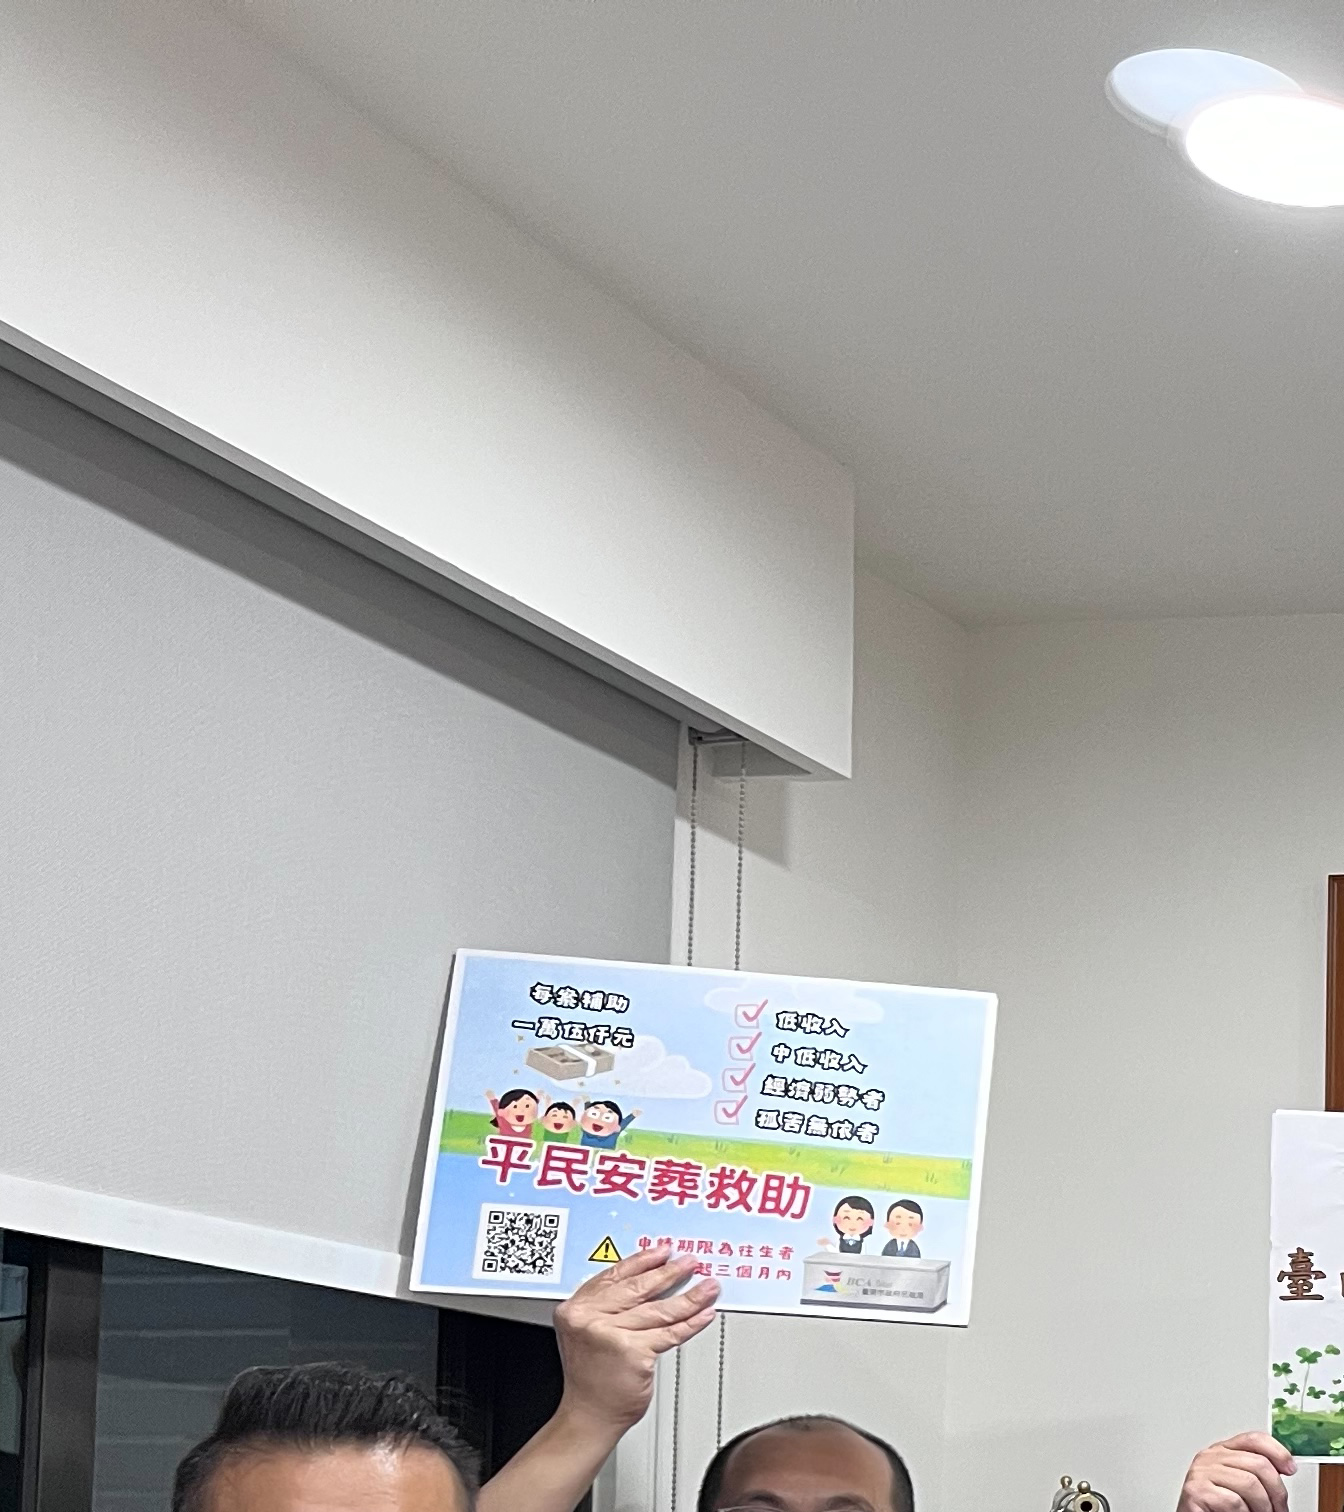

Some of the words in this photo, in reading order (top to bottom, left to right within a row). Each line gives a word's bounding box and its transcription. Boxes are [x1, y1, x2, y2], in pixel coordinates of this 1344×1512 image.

[530, 982, 630, 1015] 每案補助
[512, 1018, 635, 1049] 一萬伍仟元
[776, 1010, 850, 1038] 低收入
[771, 1043, 867, 1074] 中低收入
[761, 1075, 885, 1112] 經濟弱勢者
[756, 1109, 879, 1143] 孤苦無依者
[480, 1137, 813, 1222] 平民安葬救助
